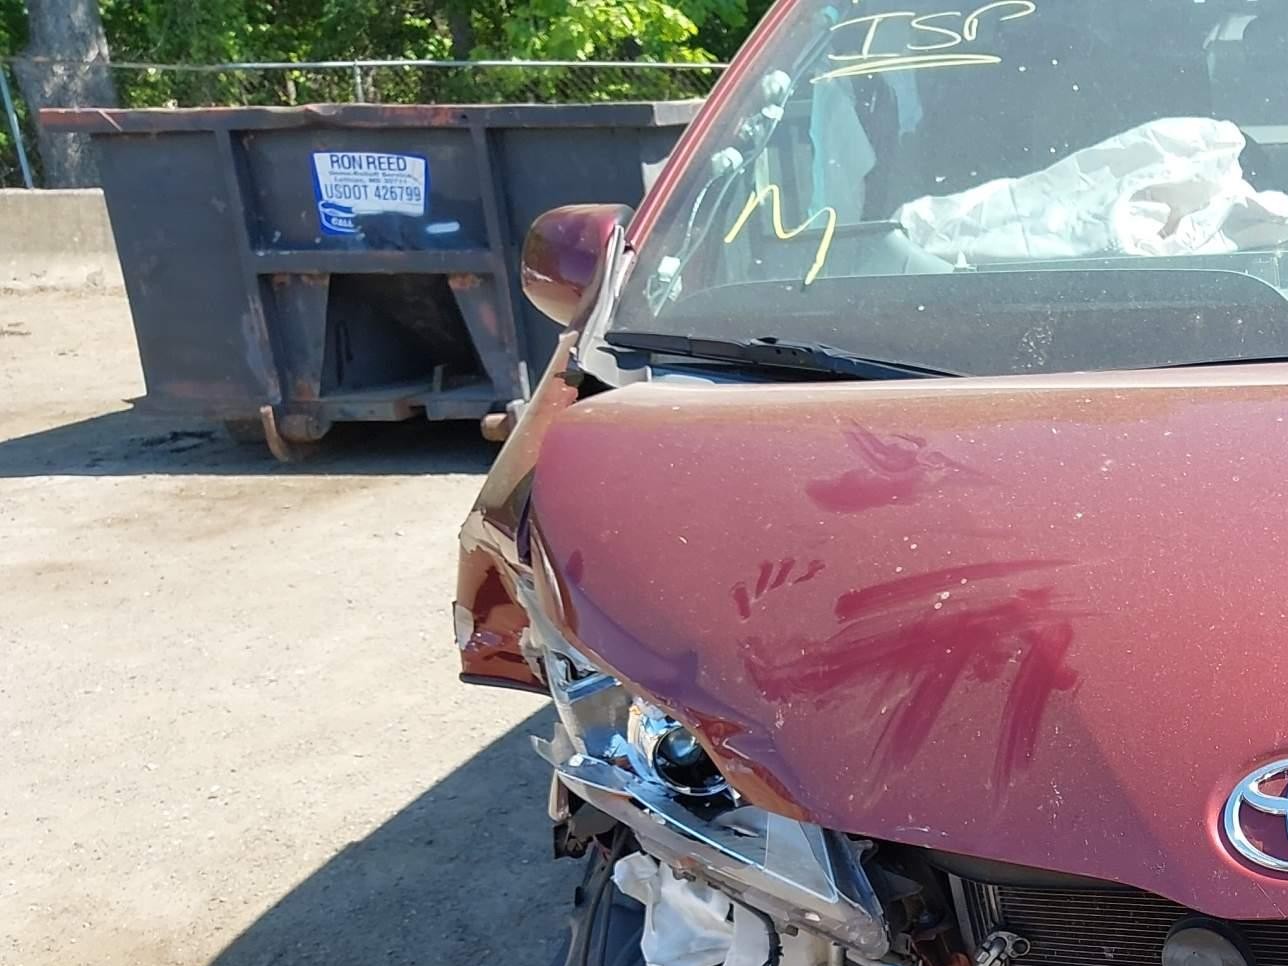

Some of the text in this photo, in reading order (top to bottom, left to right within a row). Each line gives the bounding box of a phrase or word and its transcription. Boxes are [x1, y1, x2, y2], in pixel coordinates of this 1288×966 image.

[330, 154, 407, 171] RON REED
[324, 184, 421, 201] USDOT 426799
